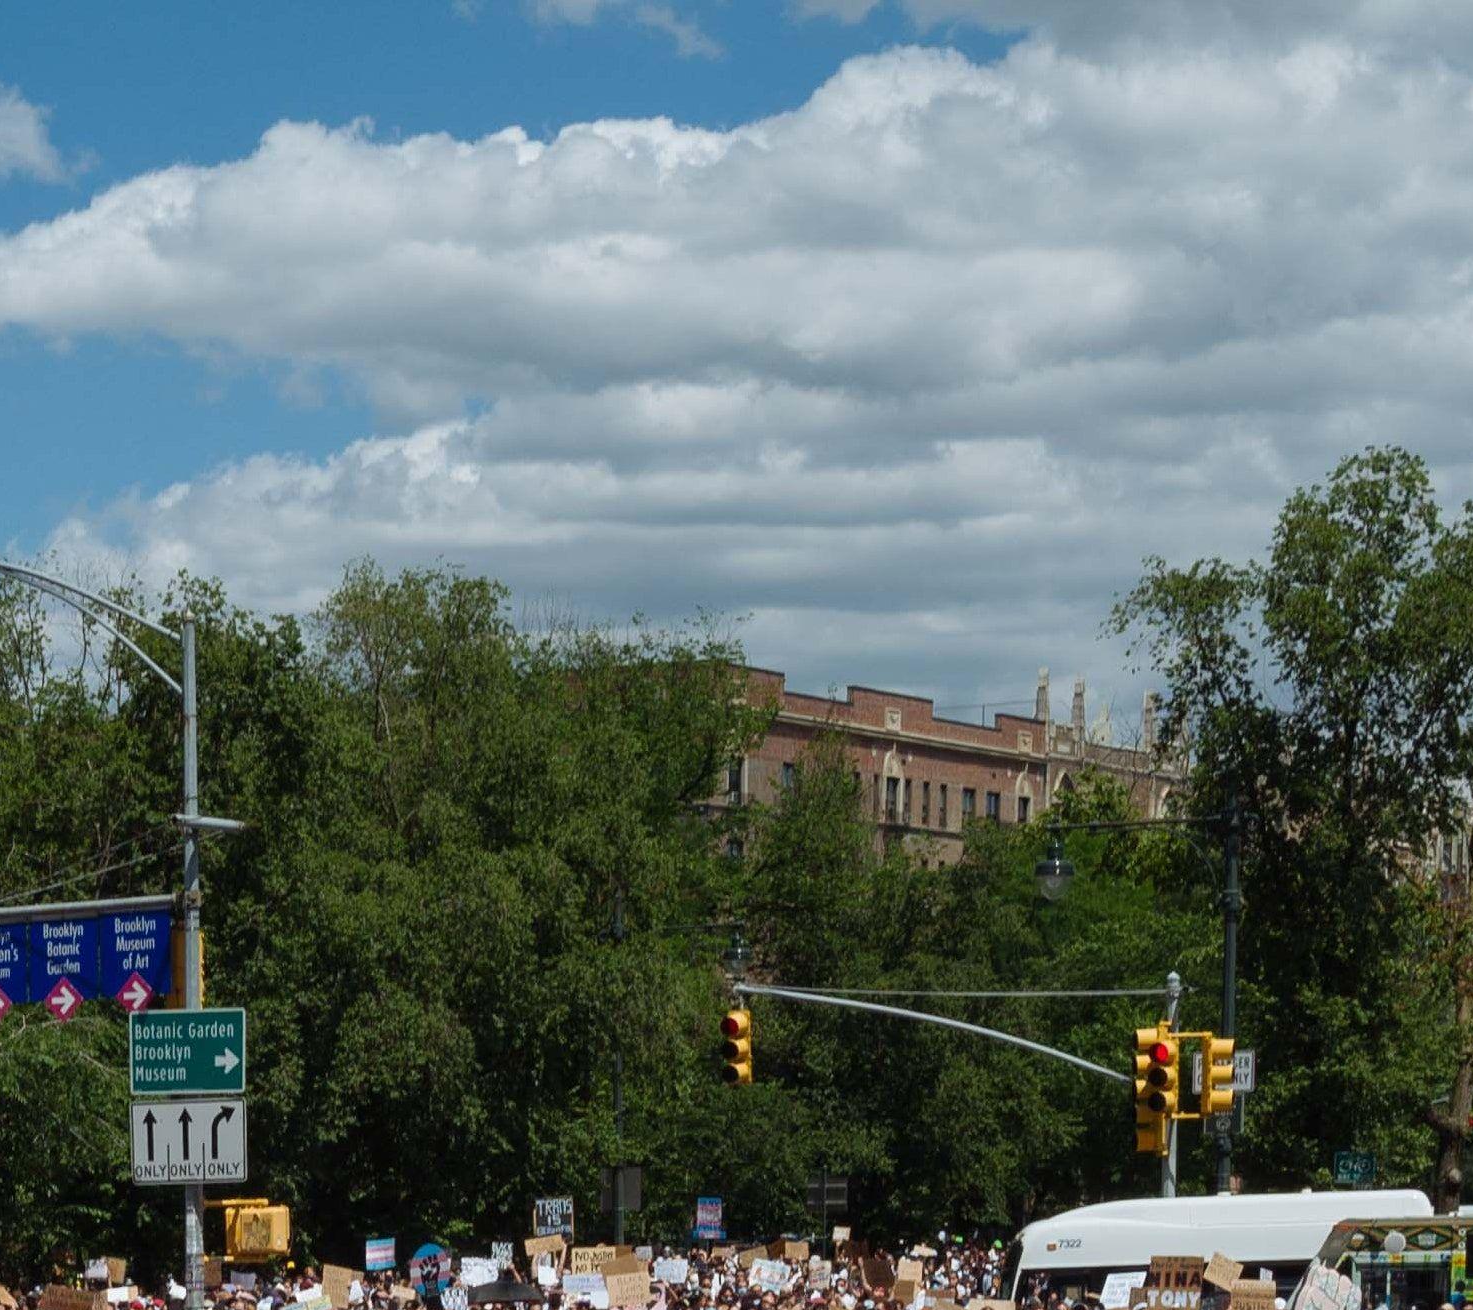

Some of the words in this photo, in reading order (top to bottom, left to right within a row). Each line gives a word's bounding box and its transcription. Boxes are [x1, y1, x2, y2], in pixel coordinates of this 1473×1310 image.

[42, 921, 84, 942] Brooklyn
[113, 915, 156, 936] Brooklyn
[46, 940, 81, 958] Botanic
[114, 933, 155, 953] Museum
[45, 957, 81, 976] Garden
[122, 953, 133, 969] of
[134, 952, 148, 969] Art
[134, 1021, 183, 1041] Botanic
[188, 1020, 234, 1039] Garden
[134, 1043, 191, 1062] Brooklyn
[135, 1064, 187, 1082] Museum
[134, 1163, 167, 1178] ONLY
[169, 1163, 202, 1177] ONLY
[207, 1162, 240, 1176] ONLY
[1057, 1239, 1082, 1249] 7322
[1146, 1290, 1201, 1309] TONY
